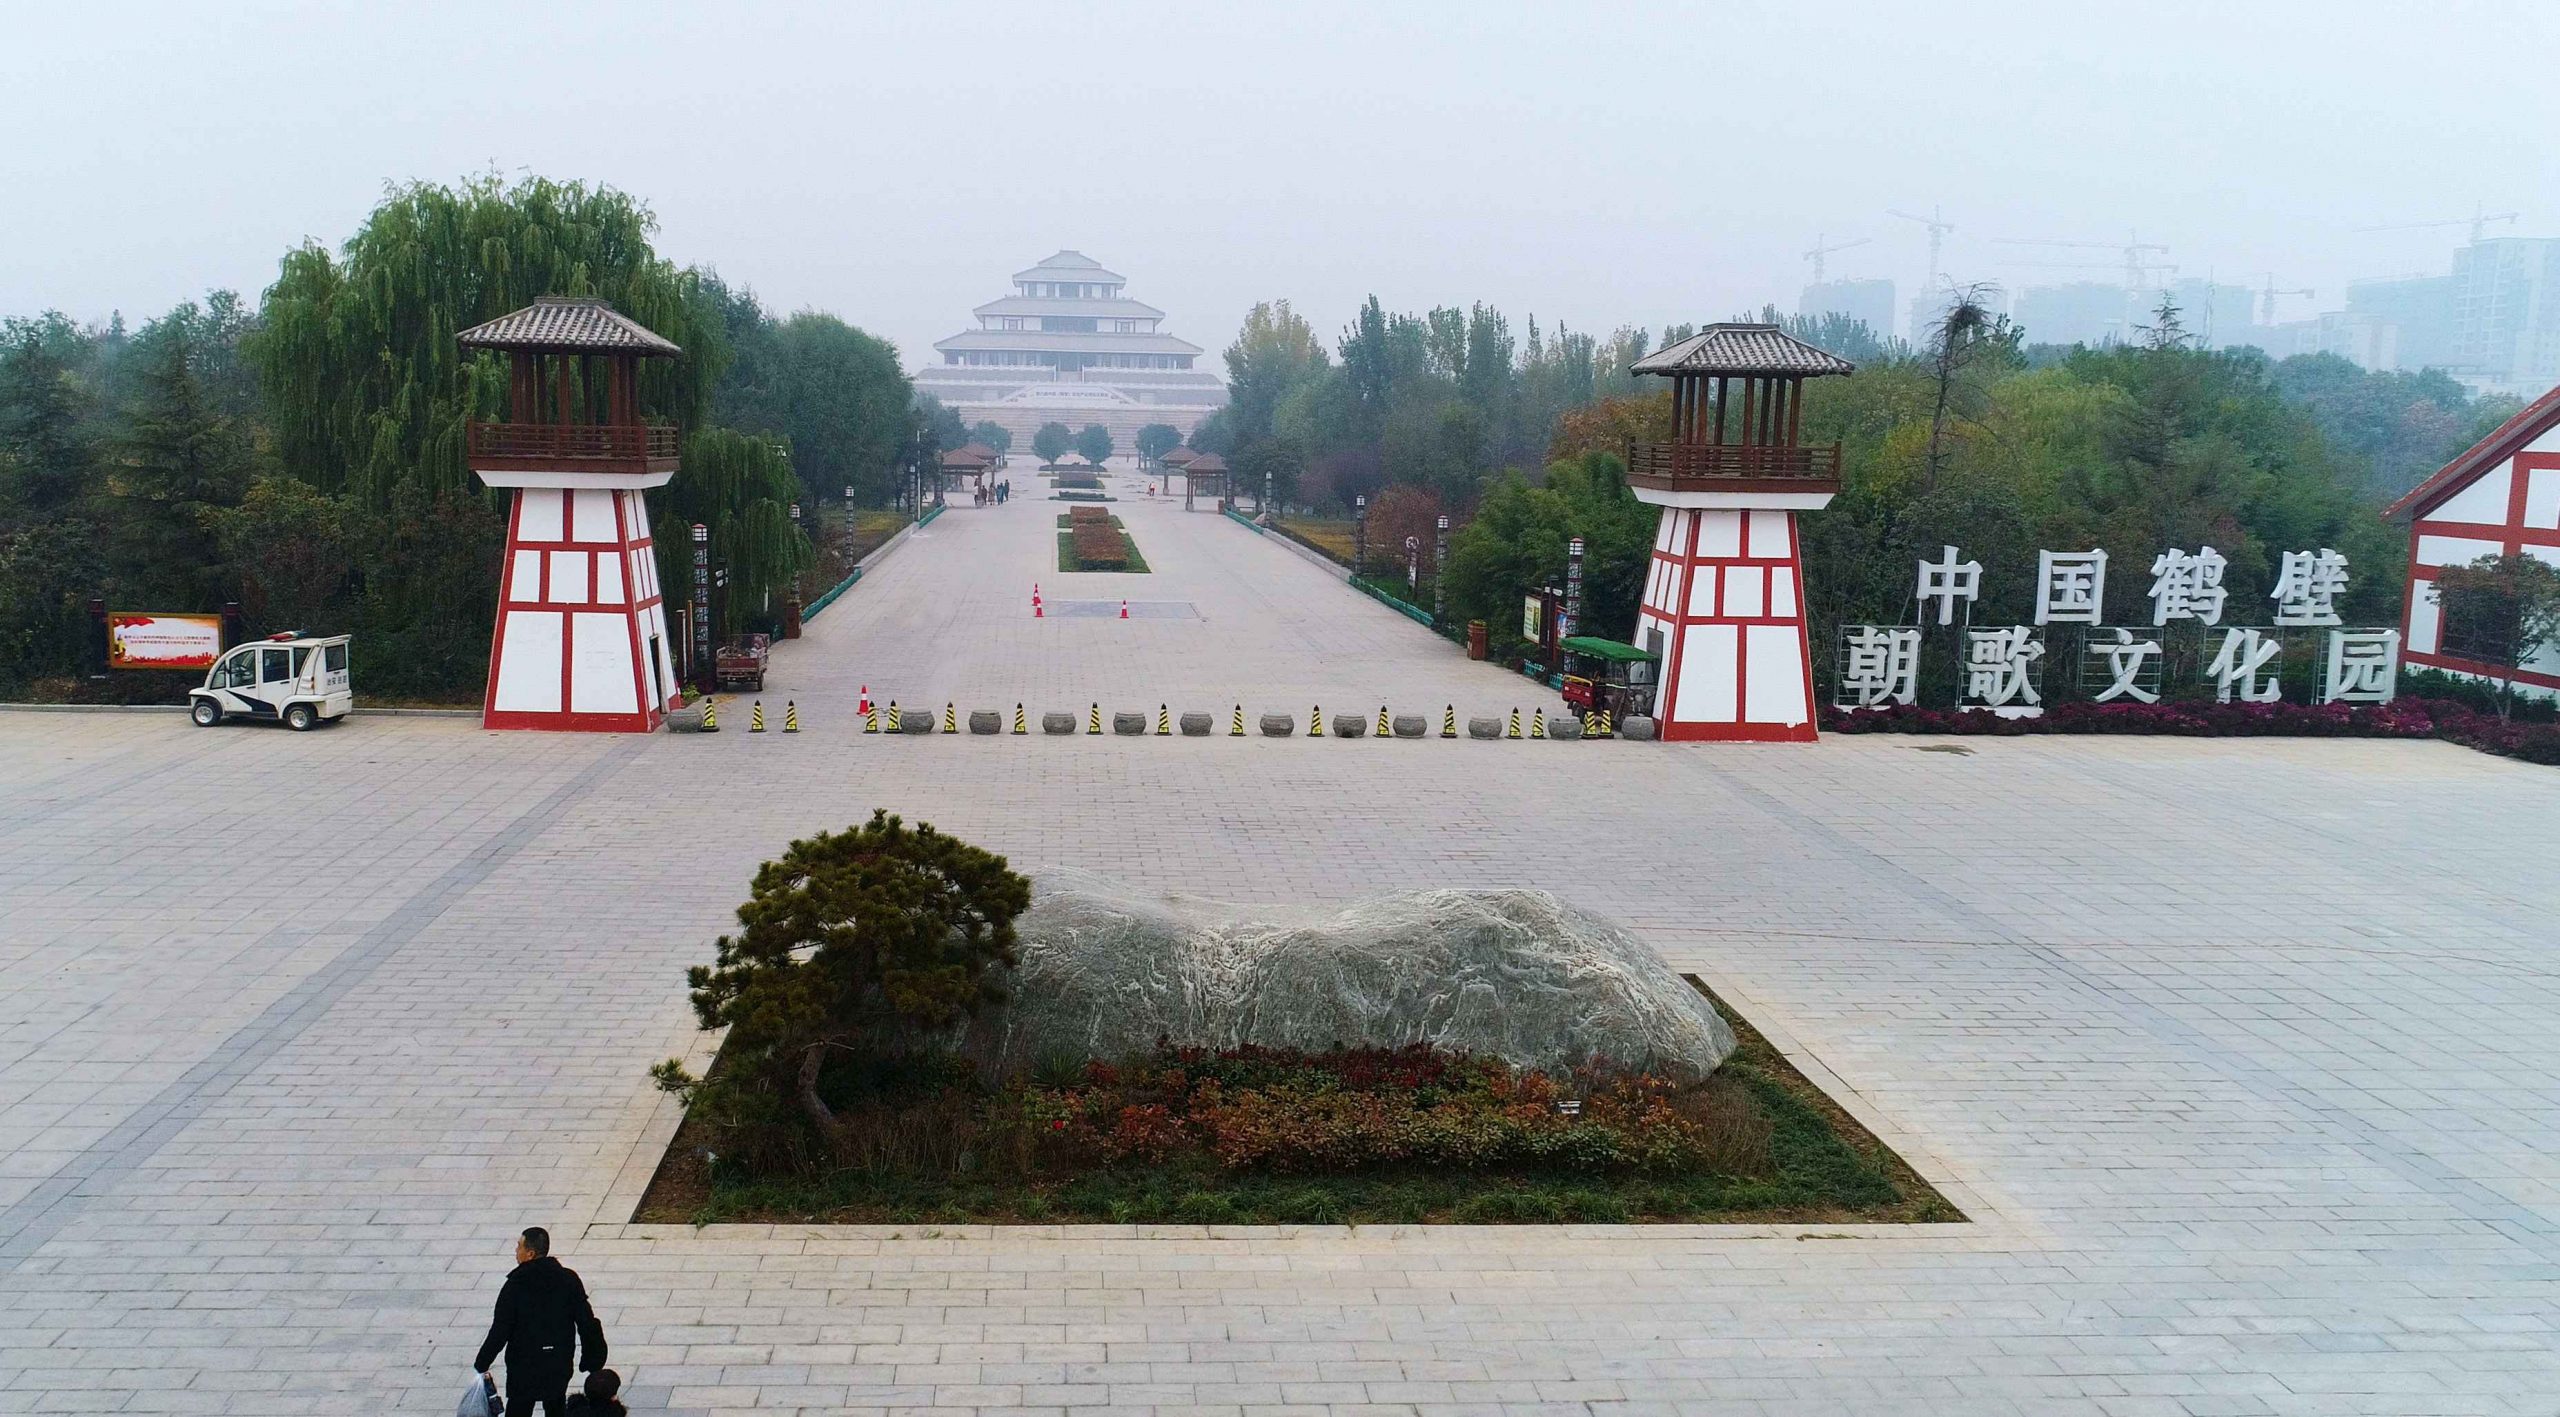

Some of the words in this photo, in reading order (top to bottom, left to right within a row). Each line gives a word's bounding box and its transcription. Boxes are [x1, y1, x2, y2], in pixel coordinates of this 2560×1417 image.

[1916, 545, 2350, 627] 中国鹤壁
[1842, 625, 2402, 706] 朝歌文化园
